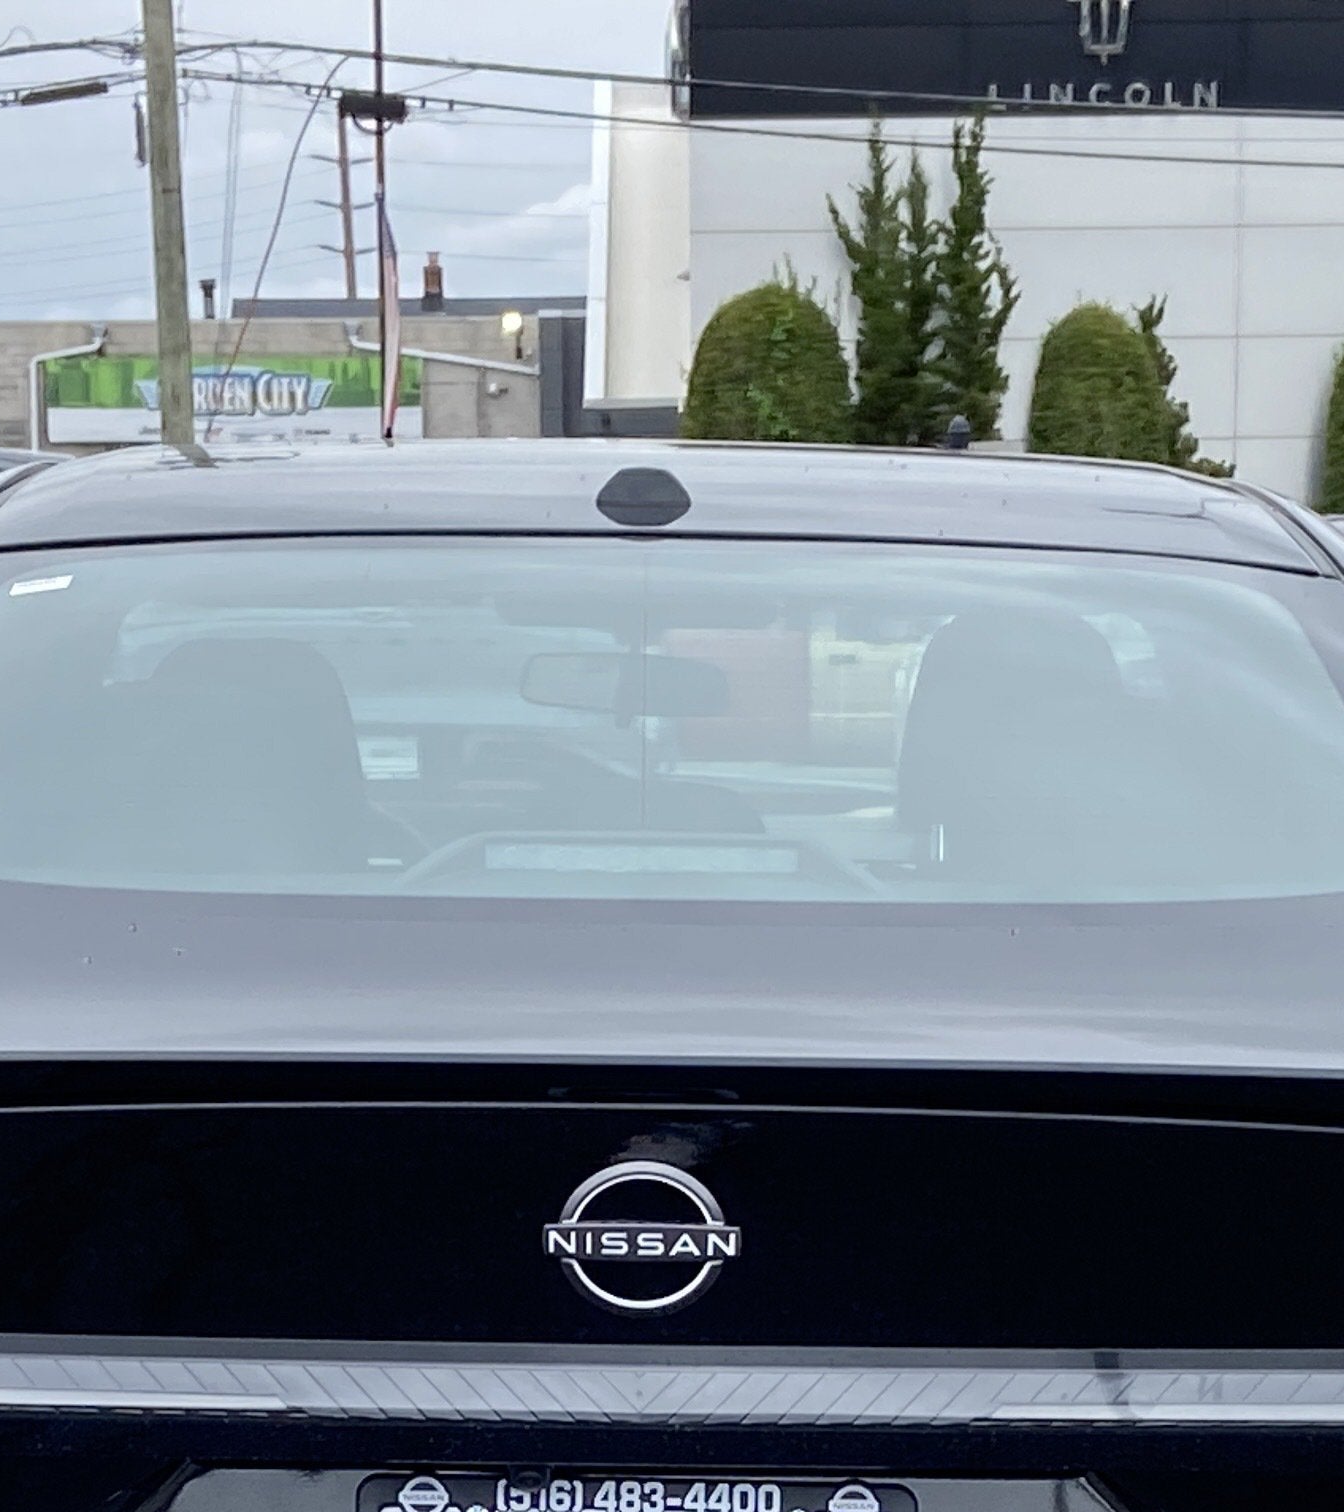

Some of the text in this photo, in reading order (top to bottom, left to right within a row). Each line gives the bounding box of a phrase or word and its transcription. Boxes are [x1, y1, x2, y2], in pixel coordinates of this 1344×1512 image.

[988, 81, 1220, 110] LINCOLN
[193, 372, 308, 411] RDEN CITY
[547, 1230, 737, 1257] NISSAN
